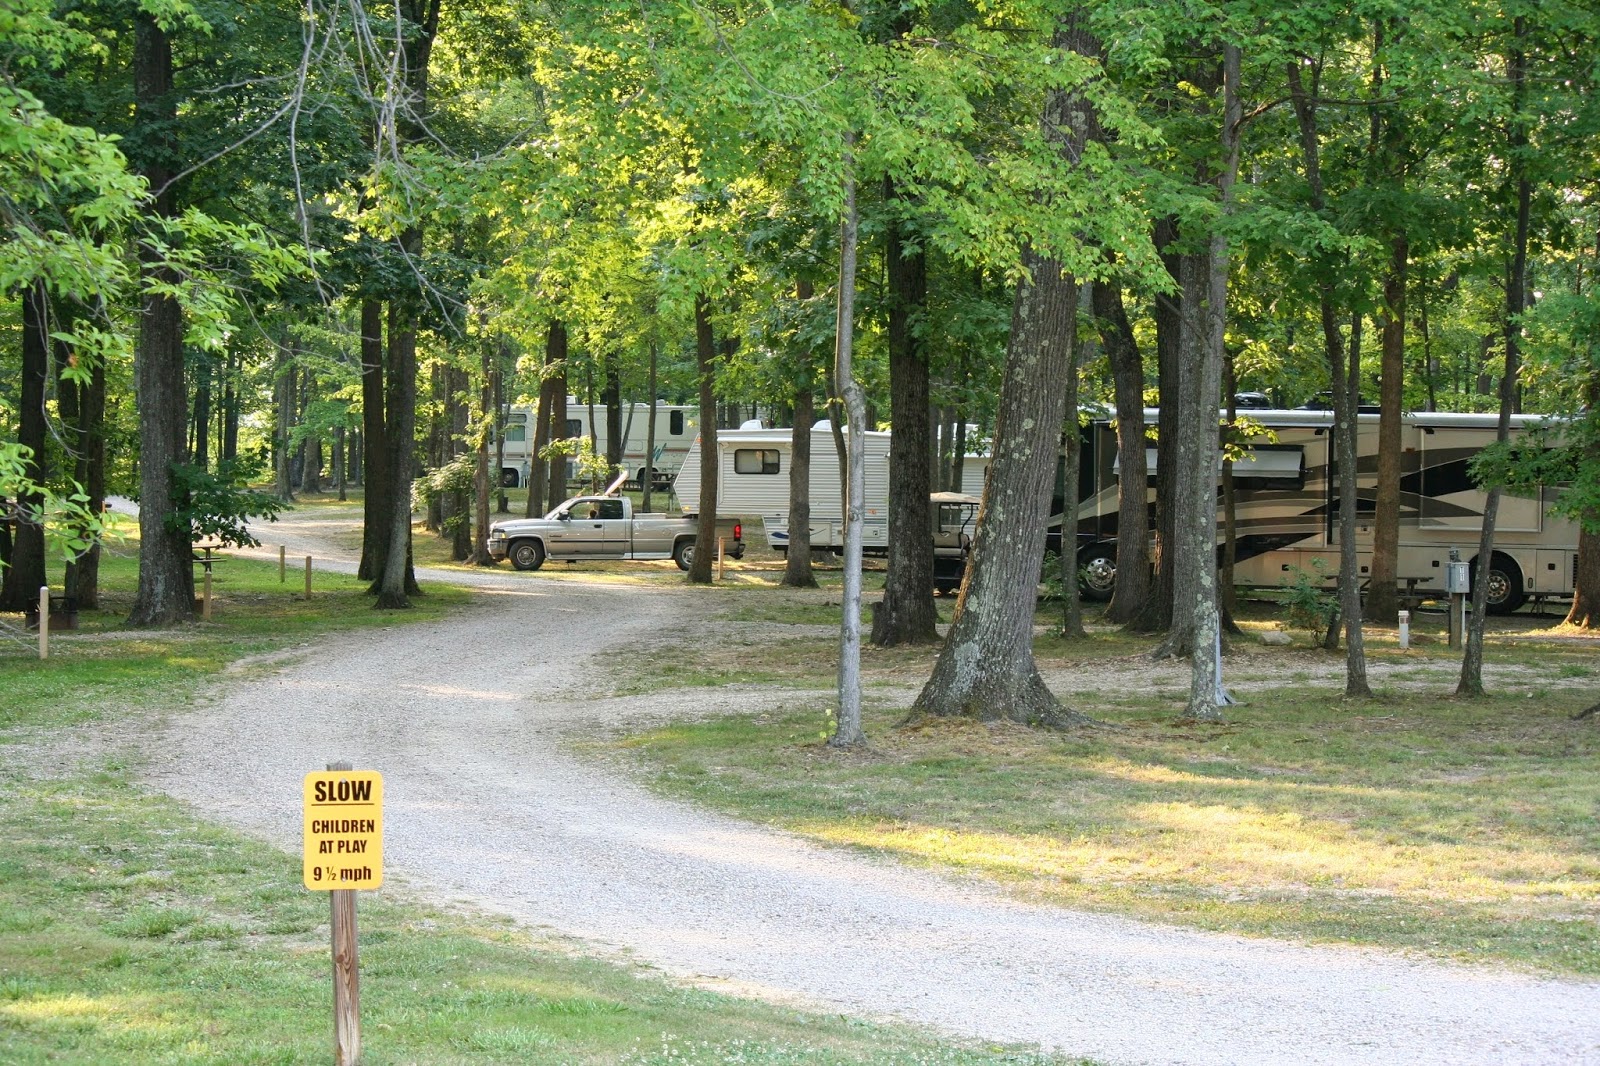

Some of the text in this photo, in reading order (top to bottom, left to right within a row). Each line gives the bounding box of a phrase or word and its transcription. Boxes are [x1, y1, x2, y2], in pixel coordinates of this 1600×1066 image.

[315, 780, 372, 802] SLOW
[312, 819, 375, 834] CHILDREN
[319, 840, 368, 854] AT PLAY
[313, 866, 322, 881] 9
[340, 866, 372, 882] mph
